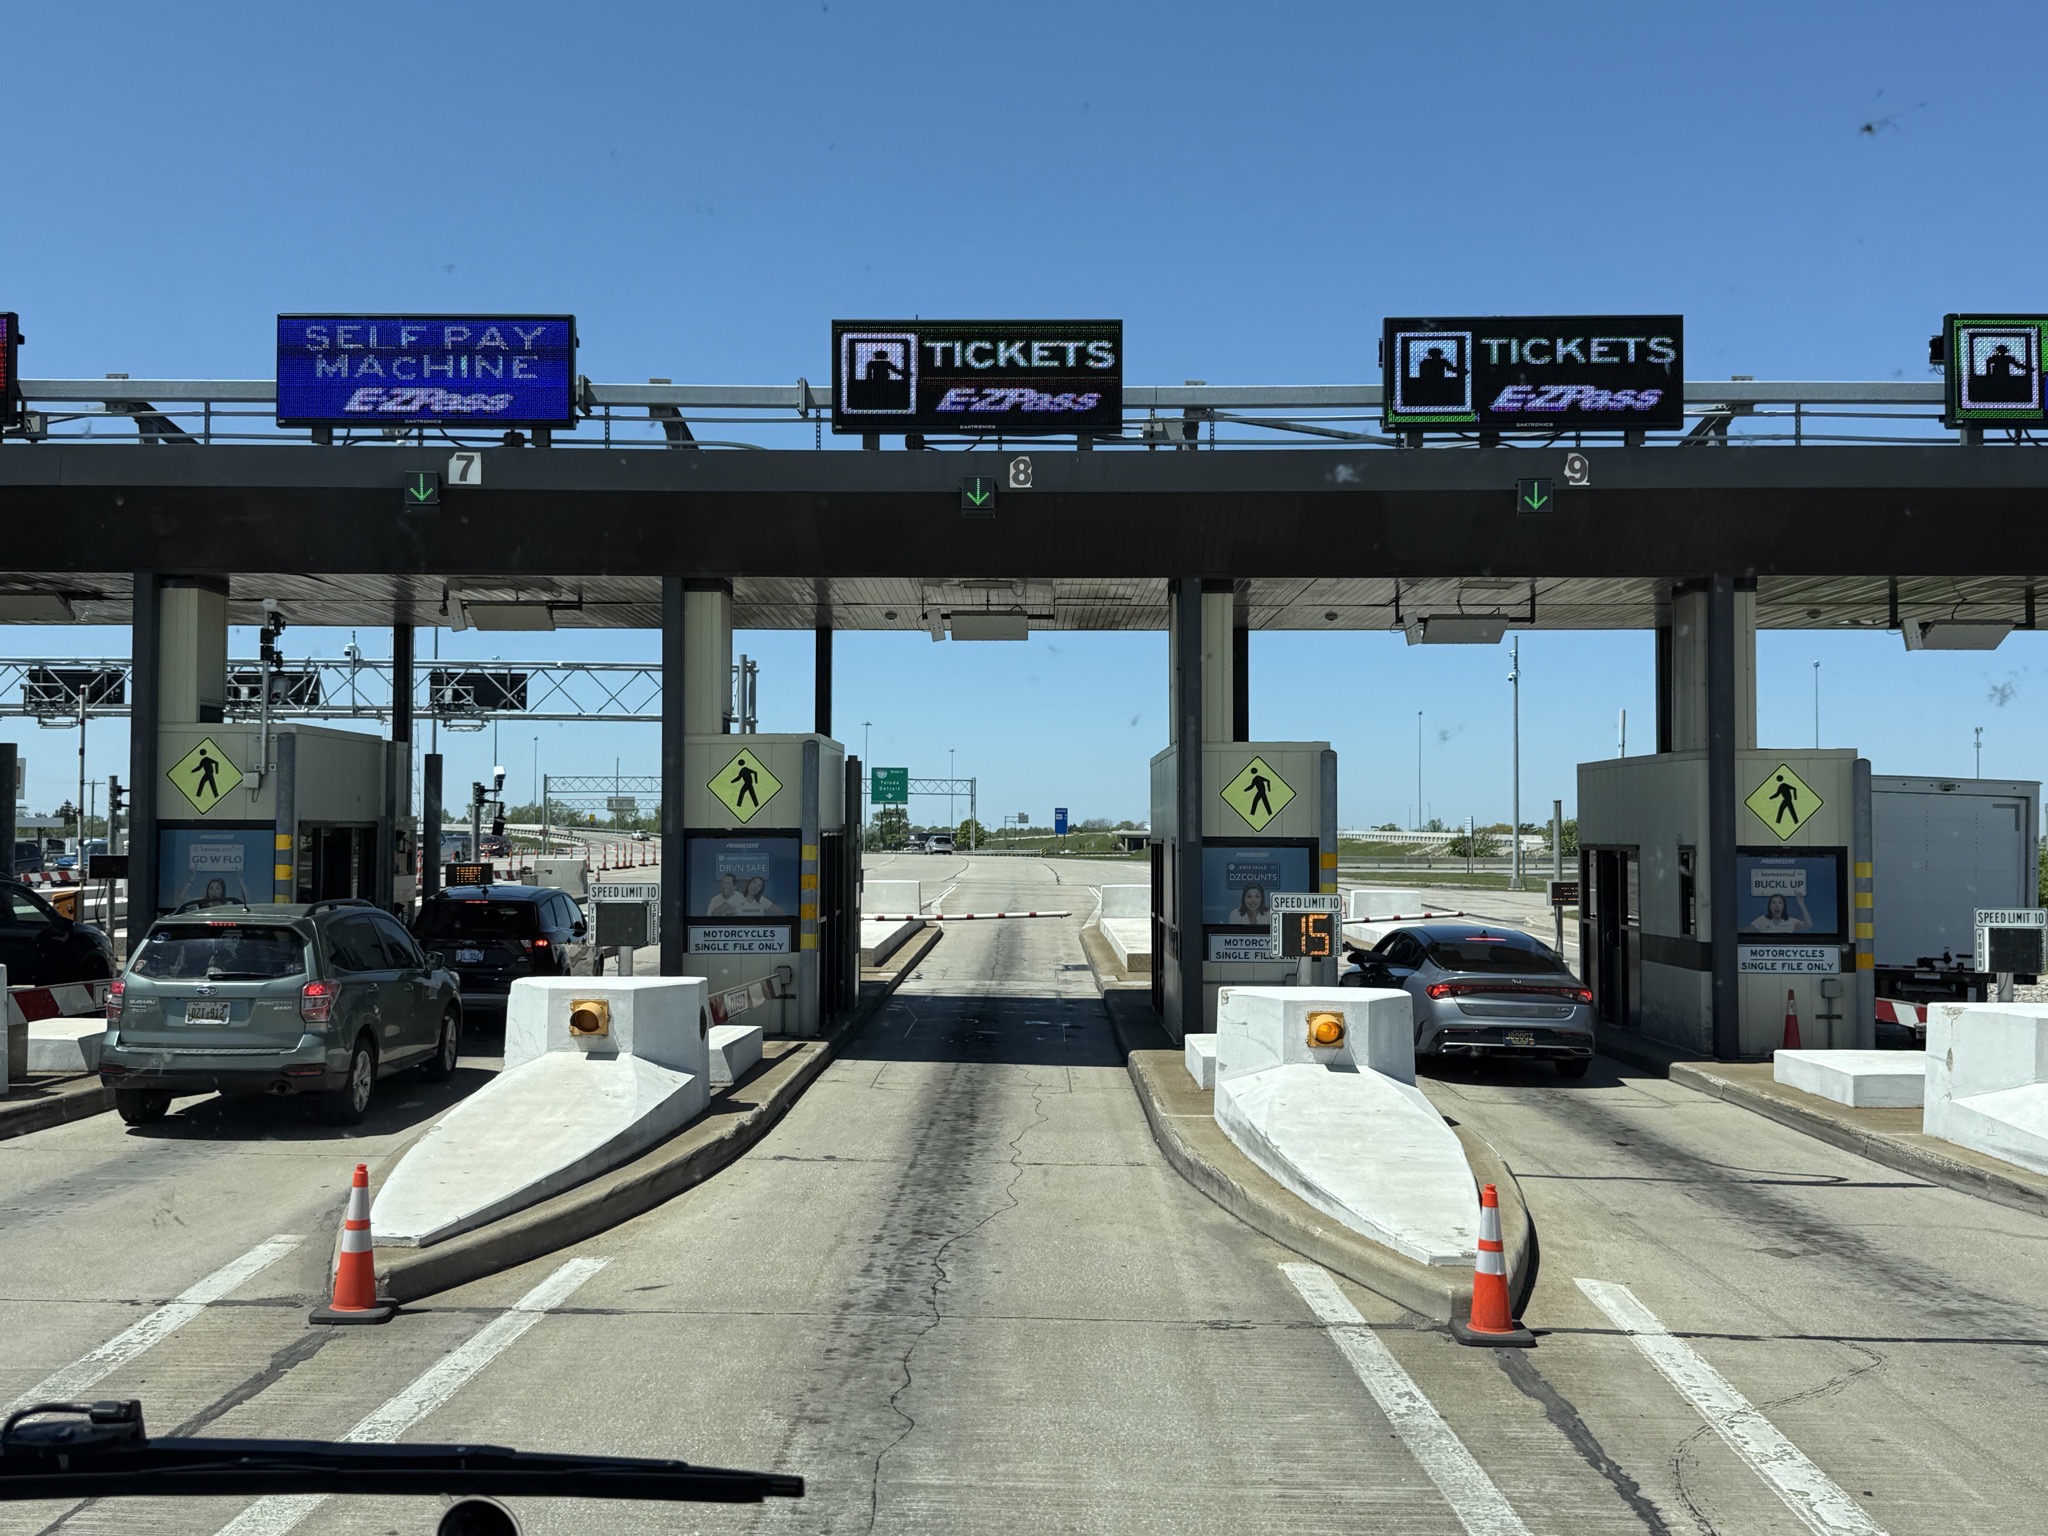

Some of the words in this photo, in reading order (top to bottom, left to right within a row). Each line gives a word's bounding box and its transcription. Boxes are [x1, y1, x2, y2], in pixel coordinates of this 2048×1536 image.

[305, 325, 427, 351] SELF
[444, 325, 546, 350] PAY
[923, 339, 1116, 370] TICKETS
[1479, 336, 1677, 365] TICKETS
[315, 354, 538, 380] MACHINE
[456, 454, 475, 482] 7
[1012, 458, 1032, 486] 8
[1567, 455, 1588, 484] 9
[192, 855, 208, 864] GO
[210, 855, 221, 864] W
[223, 855, 242, 864] FLO
[719, 864, 744, 872] DRVN
[745, 864, 767, 872] SAFE
[1229, 873, 1278, 881] DZCOUNTS
[1754, 880, 1788, 889] BUCKL
[1790, 880, 1804, 889] UP
[591, 886, 619, 898] SPEED
[621, 886, 643, 898] LIMIT
[647, 886, 656, 898] 10
[1274, 897, 1301, 909] SPEED
[1304, 897, 1325, 909] LIMIT
[1330, 897, 1339, 909] 10
[1978, 912, 2006, 924] SPEED
[2008, 912, 2031, 924] LIMIT
[2035, 912, 2044, 924] 10
[703, 929, 776, 938] MOTORCYCLES
[1301, 914, 1330, 956] 15
[694, 943, 729, 951] SINGLE
[733, 943, 754, 951] FILE
[758, 943, 785, 951] ONLY
[1224, 938, 1271, 947] MOTORCY
[1215, 951, 1250, 960] SINGLE
[1749, 949, 1825, 958] MOTORCYCLES
[1741, 962, 1777, 971] SINGLE
[1781, 962, 1803, 971] FILE
[1807, 963, 1834, 971] ONLY
[210, 1007, 225, 1019] 912
